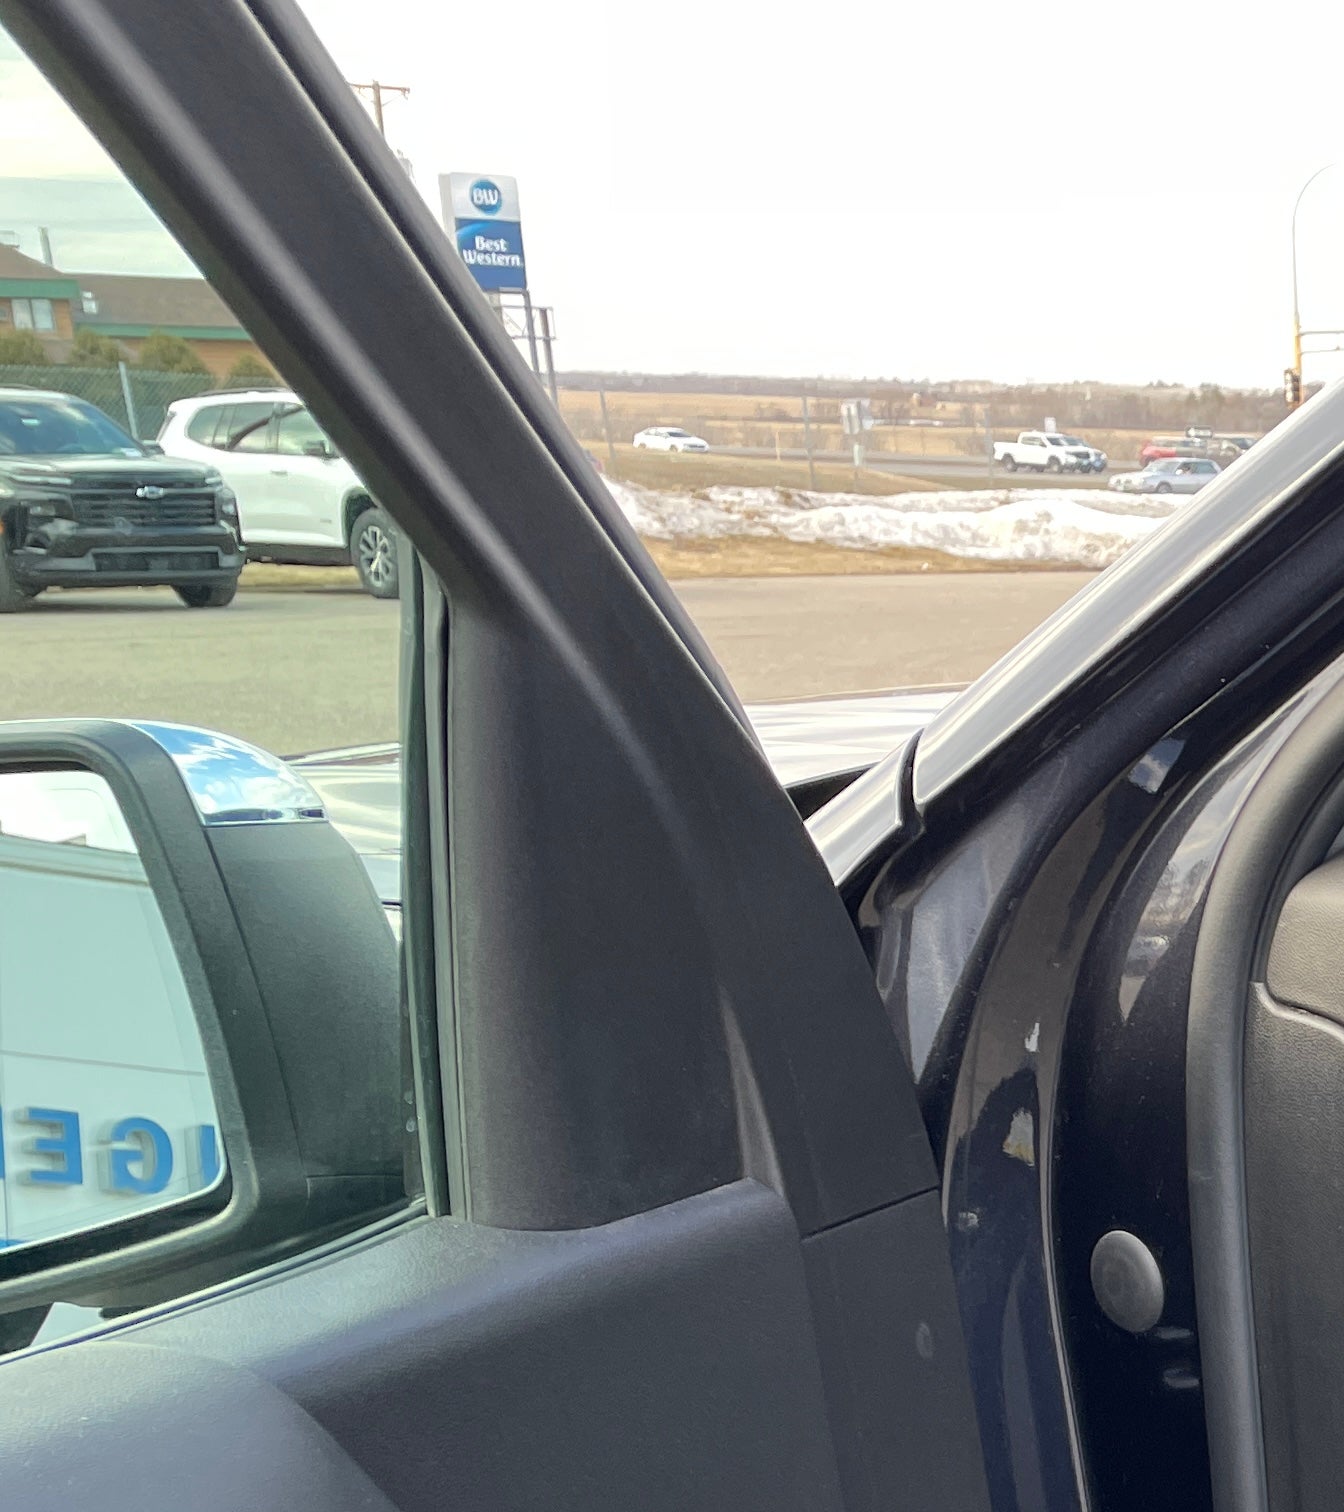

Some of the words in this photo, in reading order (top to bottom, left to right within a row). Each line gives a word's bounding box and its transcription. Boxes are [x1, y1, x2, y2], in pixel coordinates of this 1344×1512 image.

[472, 187, 499, 206] BW
[474, 235, 507, 252] Best
[462, 249, 521, 267] Western
